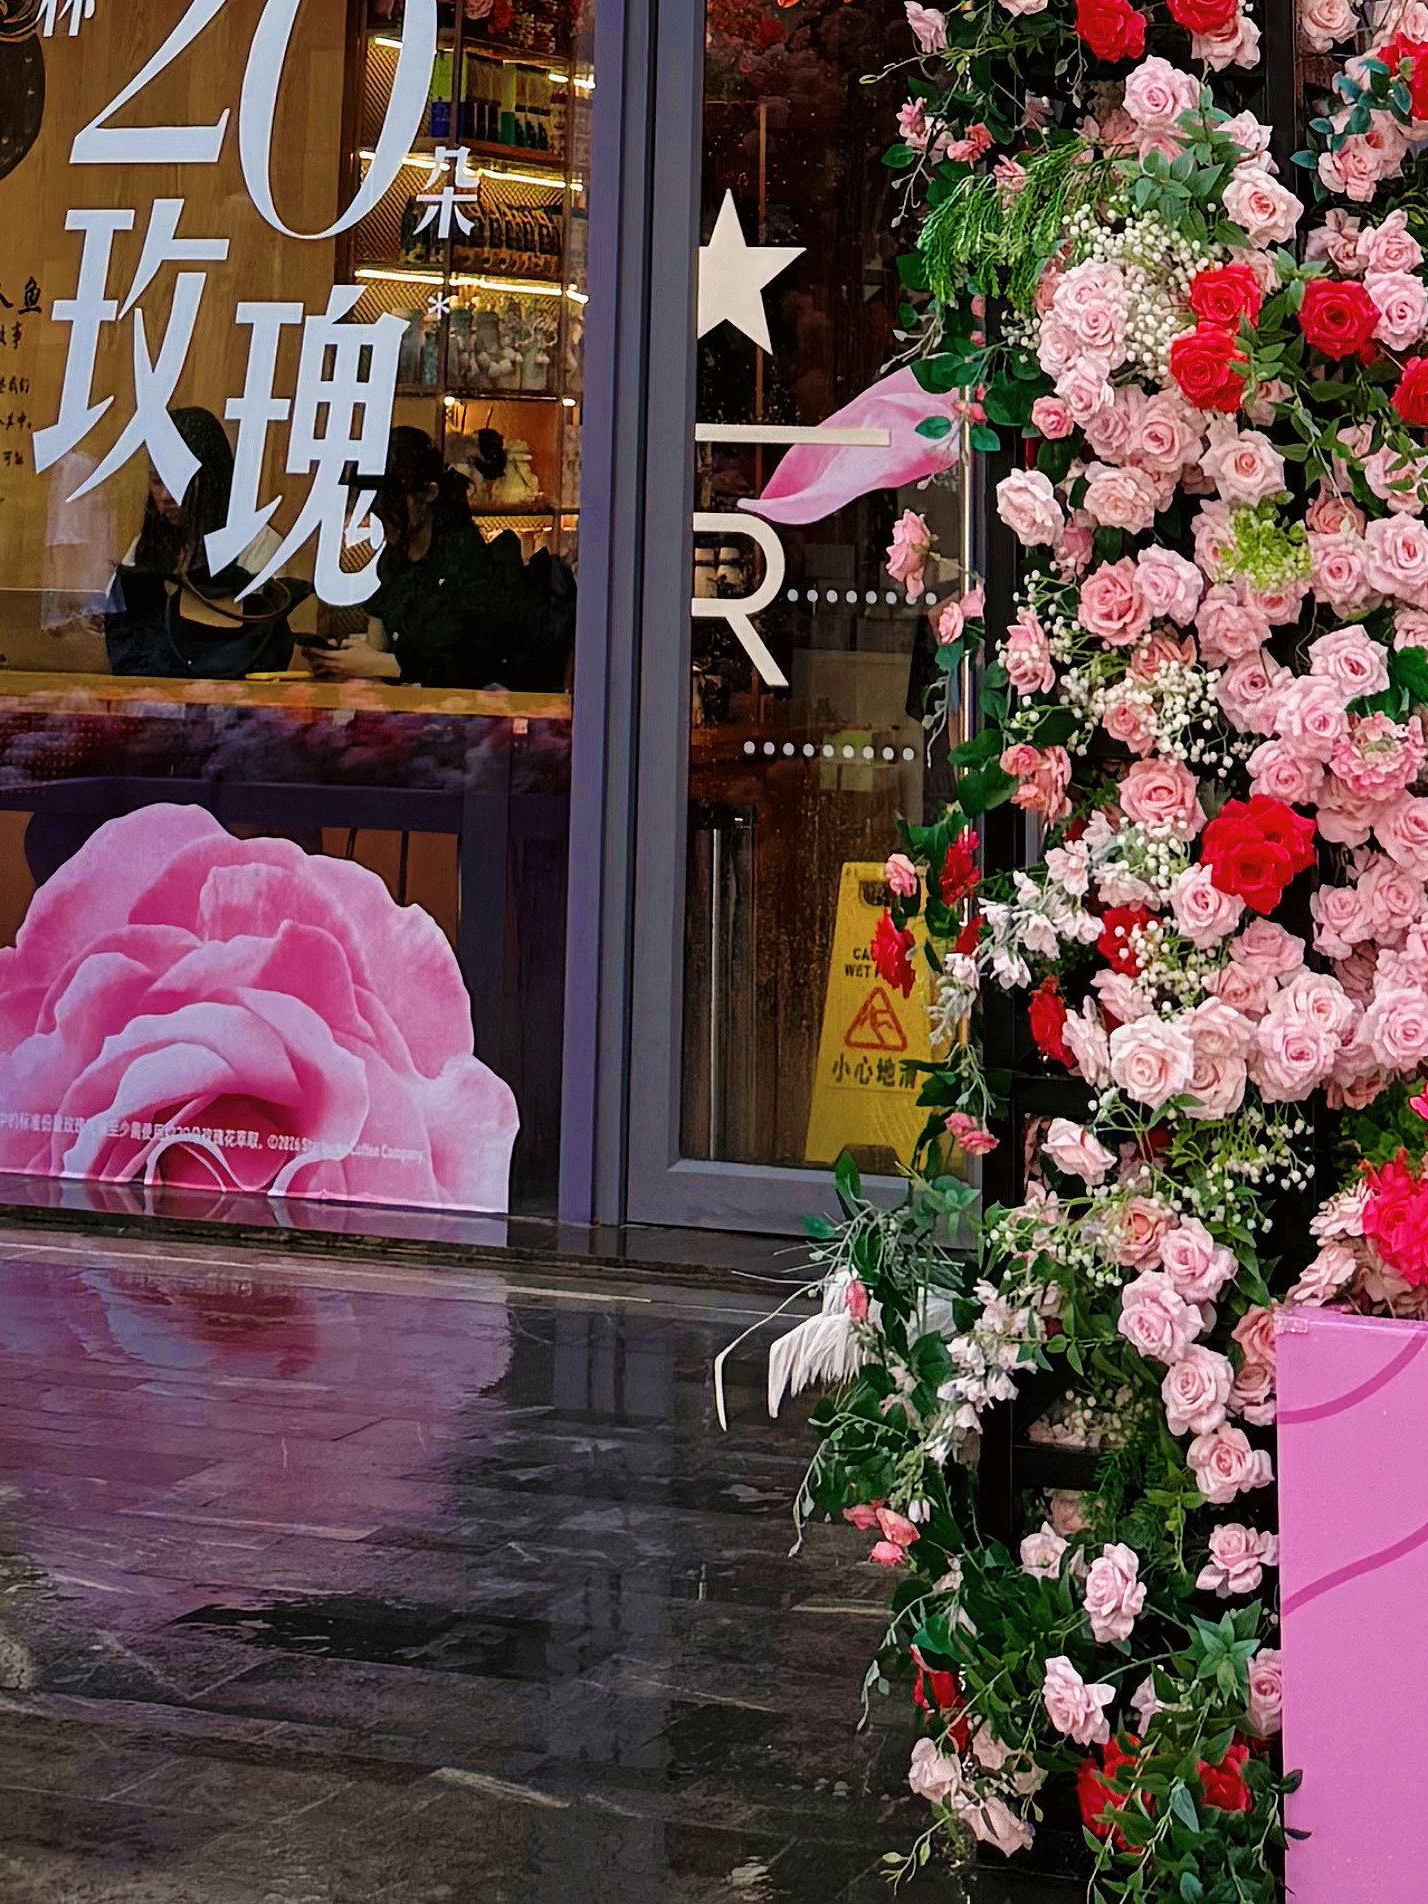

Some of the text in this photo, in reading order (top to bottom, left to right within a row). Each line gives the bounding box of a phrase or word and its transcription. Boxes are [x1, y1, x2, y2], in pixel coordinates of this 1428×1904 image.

[414, 145, 479, 239] 朵
[32, 196, 411, 608] 玫瑰
[844, 963, 870, 979] WET
